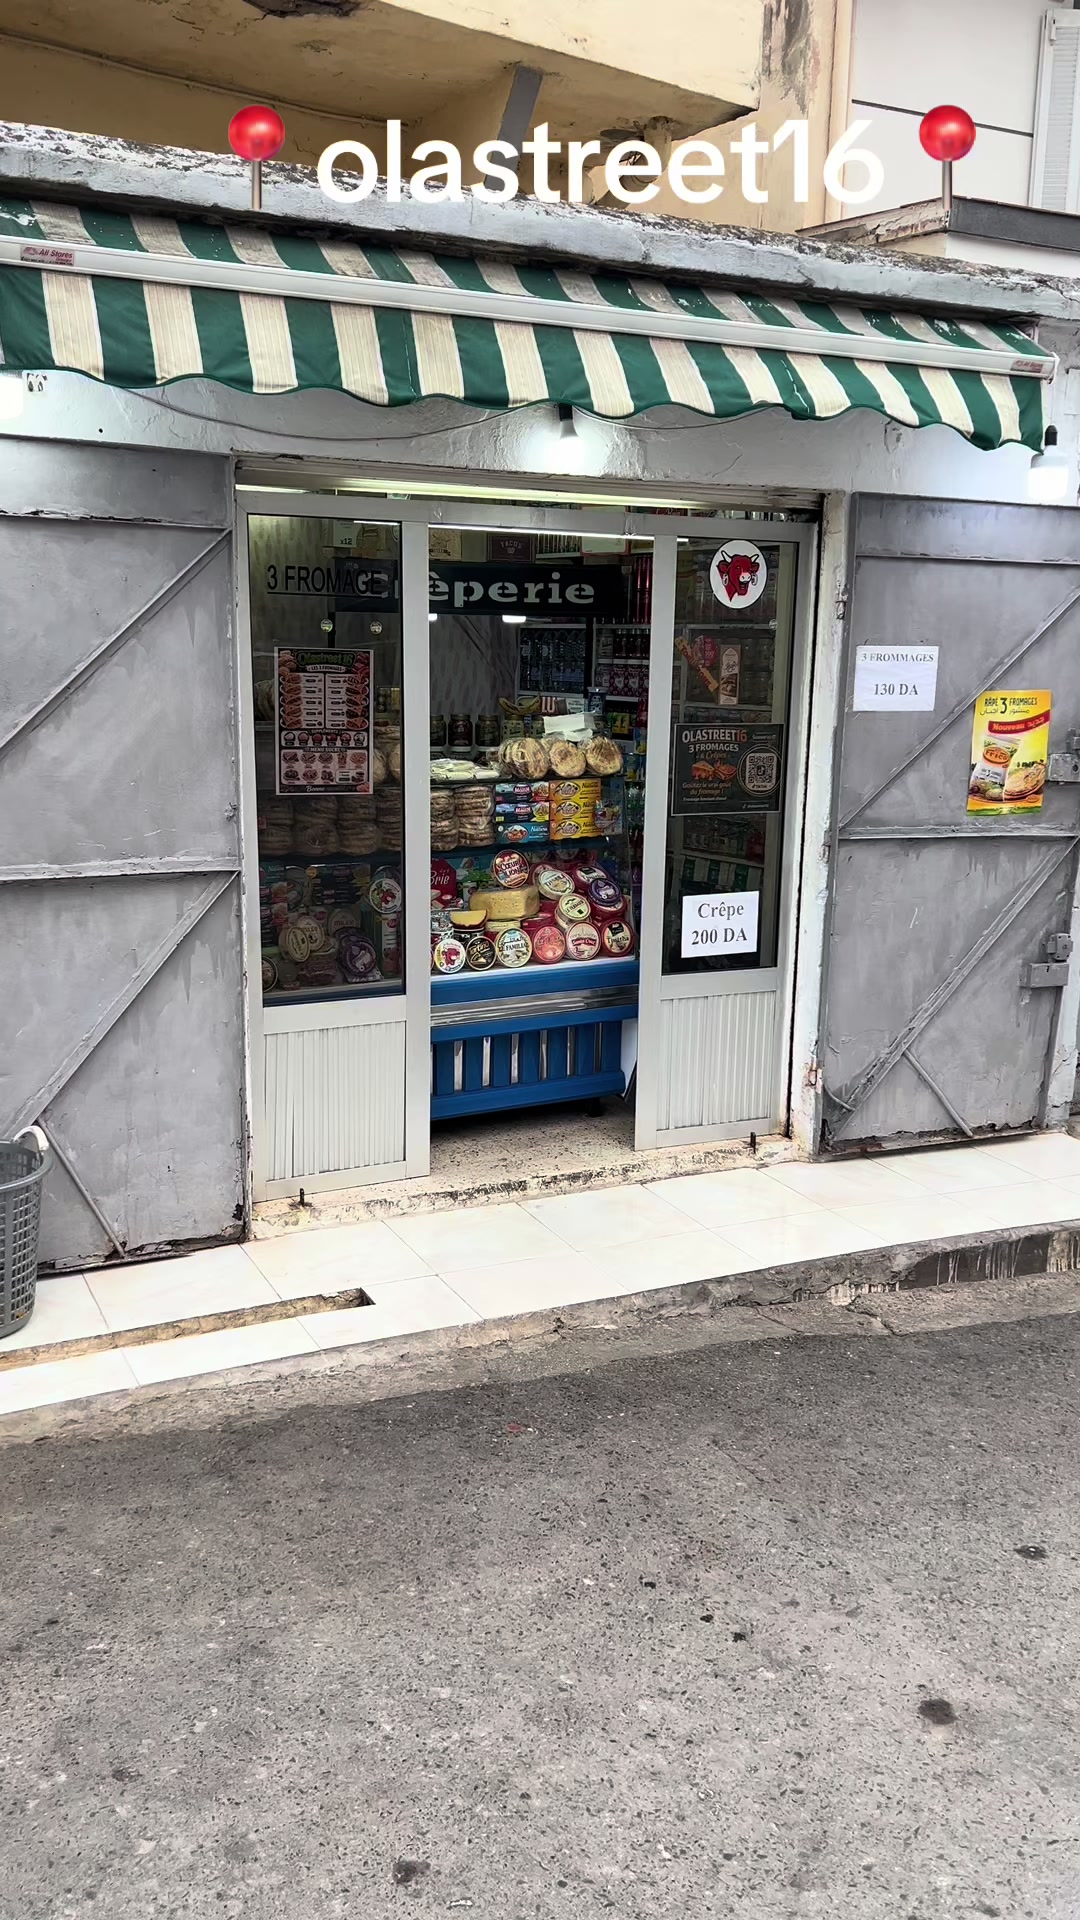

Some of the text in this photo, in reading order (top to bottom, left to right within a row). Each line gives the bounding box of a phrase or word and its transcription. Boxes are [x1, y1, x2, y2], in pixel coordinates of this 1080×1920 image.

[39, 248, 73, 259] All Stores
[267, 564, 382, 595] 3 FROMAGE
[861, 652, 934, 663] 3 FROMMAGES
[874, 683, 919, 696] 130 DA
[1000, 697, 1008, 714] 3
[1009, 697, 1038, 706] FROMAGES
[992, 723, 1026, 731] Nouveau
[688, 743, 739, 753] 3 FROMAGES
[697, 901, 745, 921] Crêpe
[691, 927, 748, 946] 200 DA
